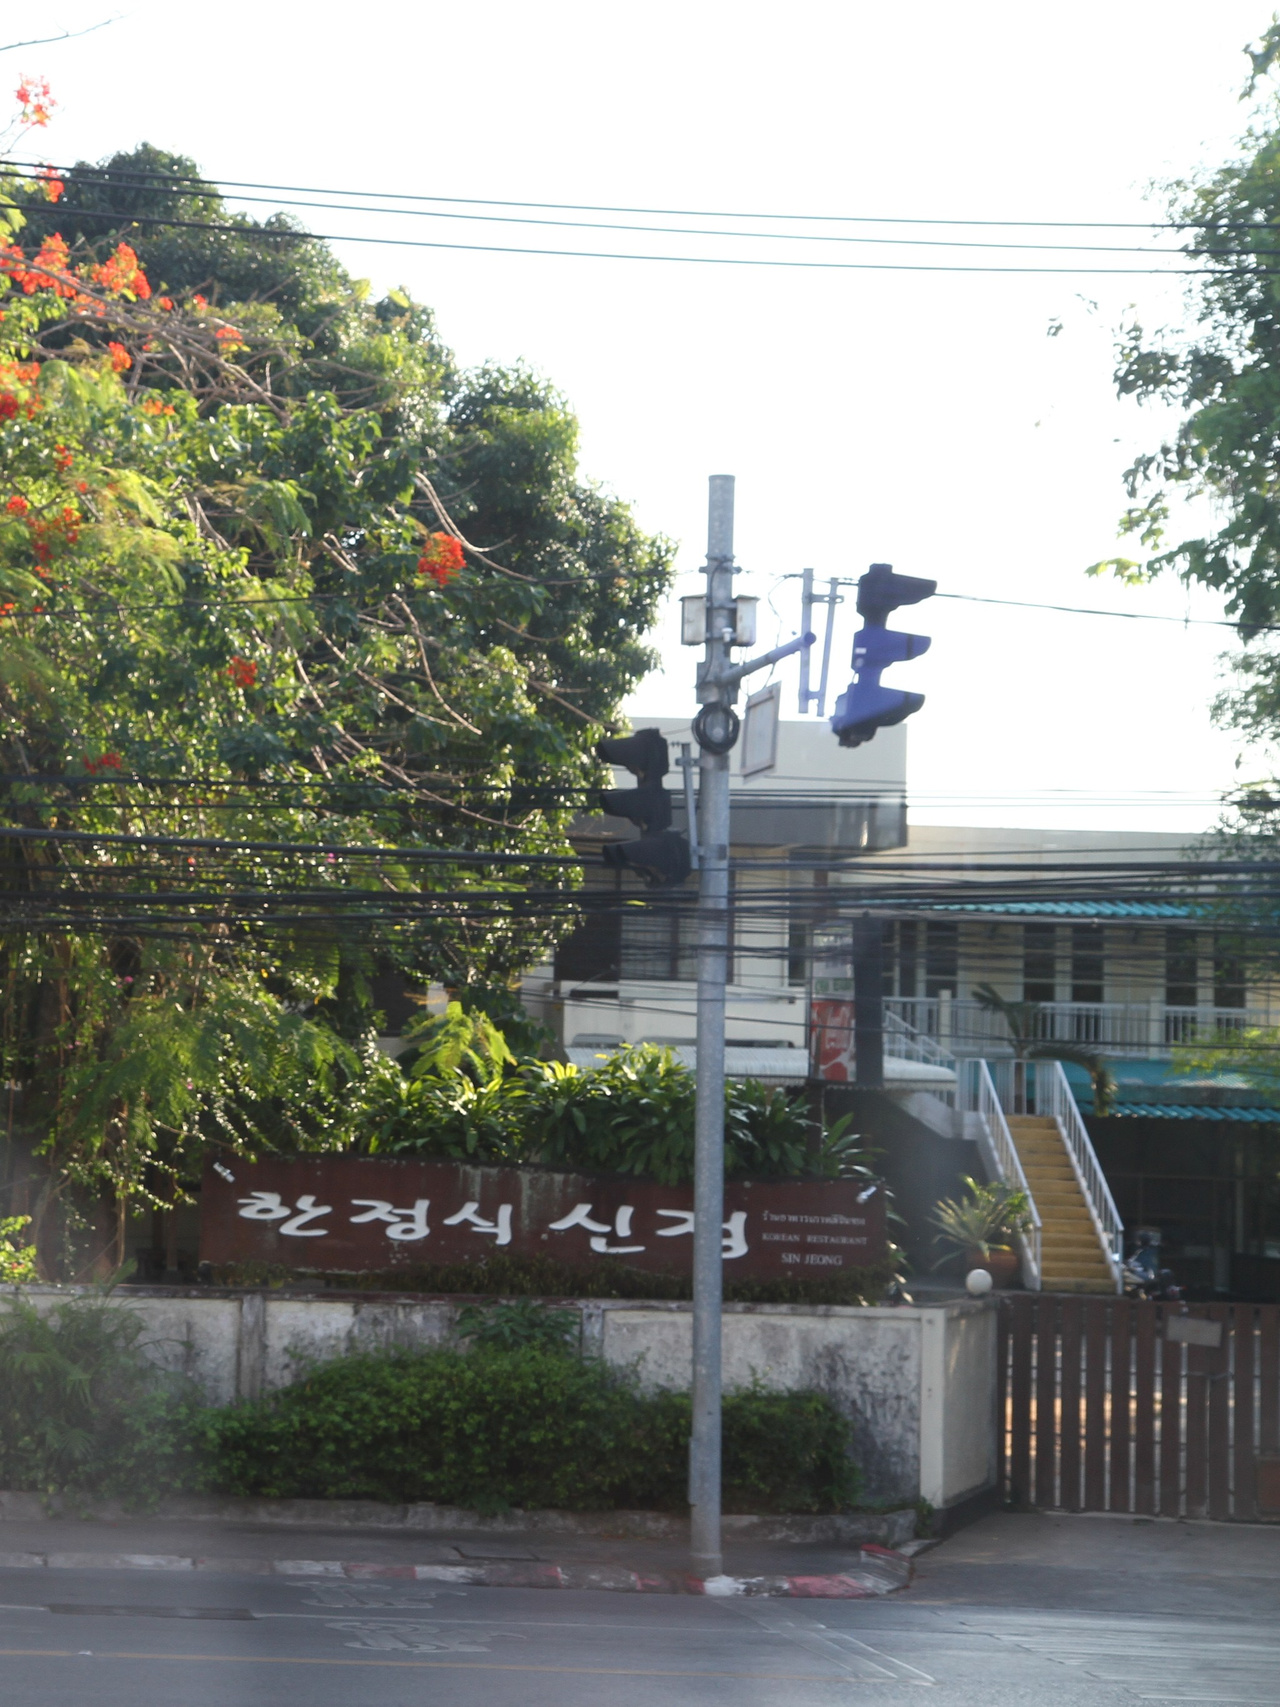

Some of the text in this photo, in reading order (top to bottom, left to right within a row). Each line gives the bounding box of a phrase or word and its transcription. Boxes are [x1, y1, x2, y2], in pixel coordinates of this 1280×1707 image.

[237, 1191, 513, 1246] 한정식
[761, 1232, 868, 1245] KOREAN RESTAURANT
[781, 1252, 843, 1266] SIN JEONG
